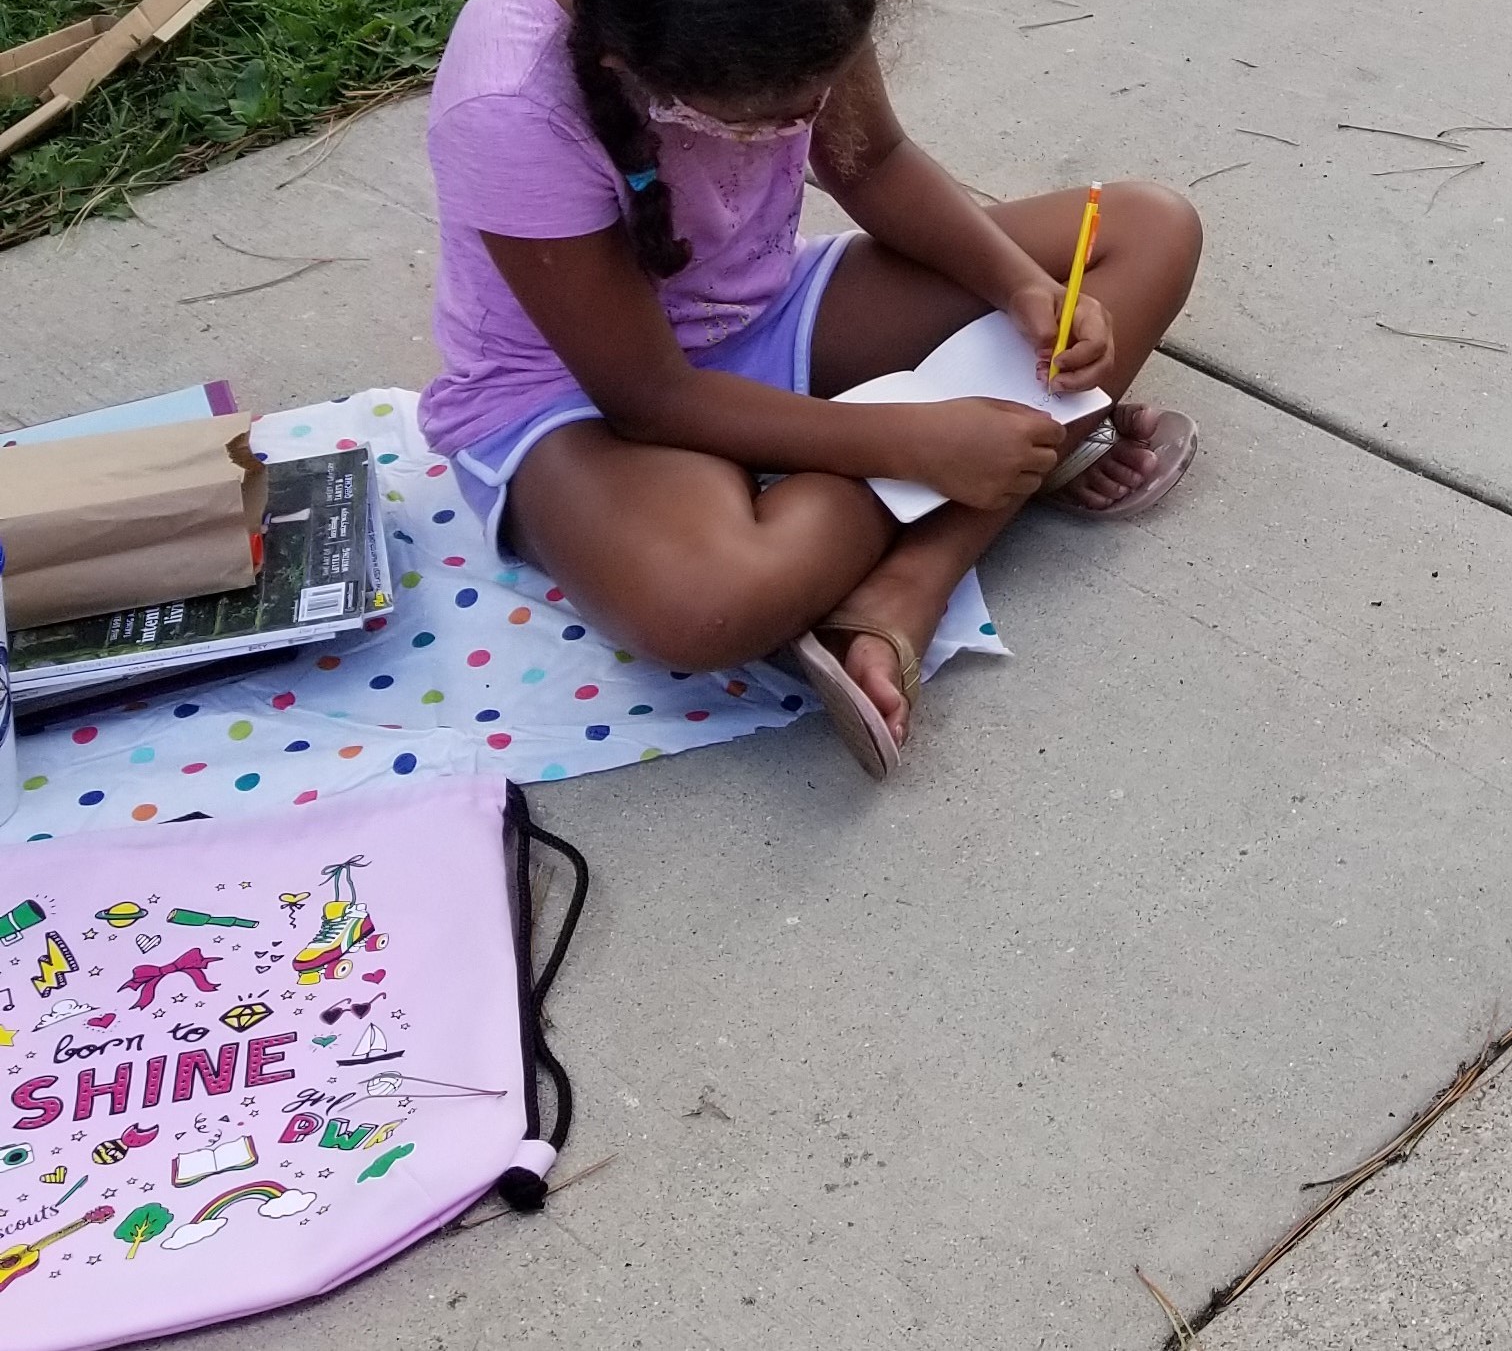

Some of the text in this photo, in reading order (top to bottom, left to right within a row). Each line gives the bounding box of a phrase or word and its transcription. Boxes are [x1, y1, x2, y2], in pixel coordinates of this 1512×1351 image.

[53, 1022, 211, 1064] born to
[11, 1032, 298, 1130] SHINE
[281, 1088, 357, 1116] girl
